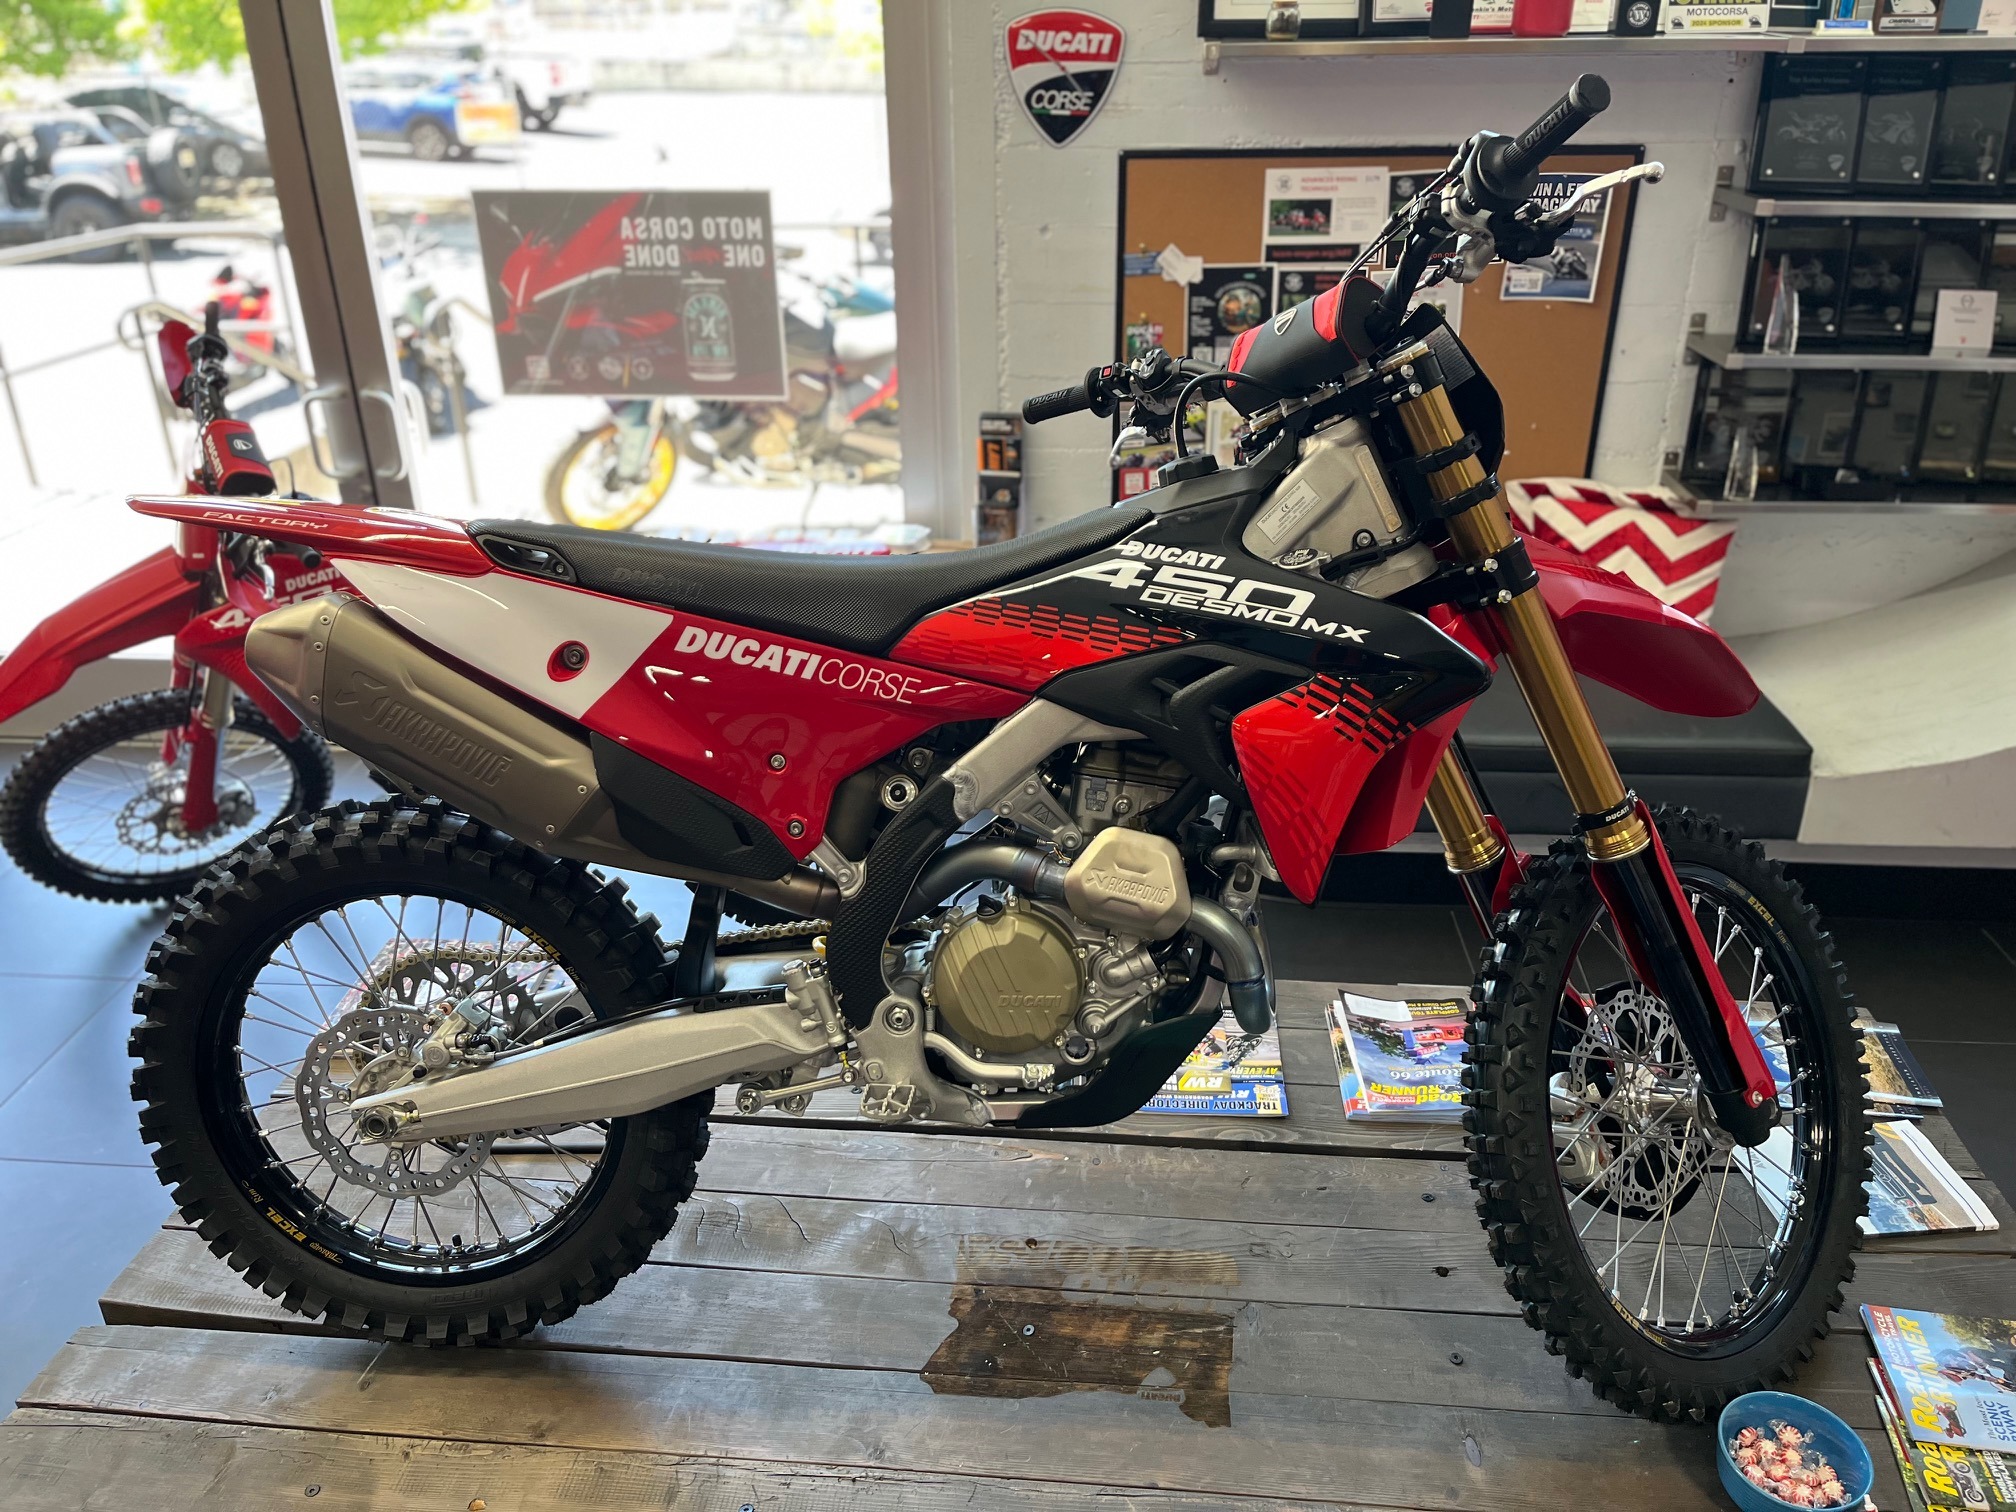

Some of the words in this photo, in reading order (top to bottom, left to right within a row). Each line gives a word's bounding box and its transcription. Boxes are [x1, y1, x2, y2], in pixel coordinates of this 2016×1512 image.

[1686, 8, 1748, 16] MOTOCORSA
[1016, 29, 1114, 54] DUCATI
[1031, 89, 1095, 111] CORSE
[1524, 100, 1571, 149] DUCATI
[1031, 389, 1068, 405] DUCATI
[205, 434, 224, 478] DUCATI
[203, 511, 329, 529] FACTORY
[1113, 540, 1227, 570] DUCATI
[611, 567, 701, 599] DUCATI
[1060, 558, 1316, 616] 450
[1138, 585, 1301, 627] DESMO
[1300, 617, 1372, 643] MX
[674, 625, 821, 680] DUCATI
[818, 658, 922, 704] CORSE
[1605, 805, 1630, 822] DUCATI
[1747, 895, 1775, 927] EXCEL
[520, 925, 562, 961] EXCEL
[565, 966, 580, 982] Rim
[997, 993, 1062, 1009] DUCATI
[1184, 1076, 1224, 1089] RW
[1229, 1067, 1263, 1075] EVERY
[1264, 1067, 1278, 1075] AT
[1390, 1071, 1411, 1080] 66
[1414, 1068, 1463, 1079] Route
[1370, 1082, 1441, 1096] RUNNER
[1416, 1092, 1466, 1105] Road
[1213, 1100, 1278, 1110] TRACKDAY
[266, 1206, 307, 1242] EXCEL
[1873, 1310, 1900, 1364] MOTORCYCLE
[1896, 1315, 1958, 1405] RUNNER
[1891, 1364, 1944, 1434] Road
[1983, 1400, 2011, 1441] SCENIC
